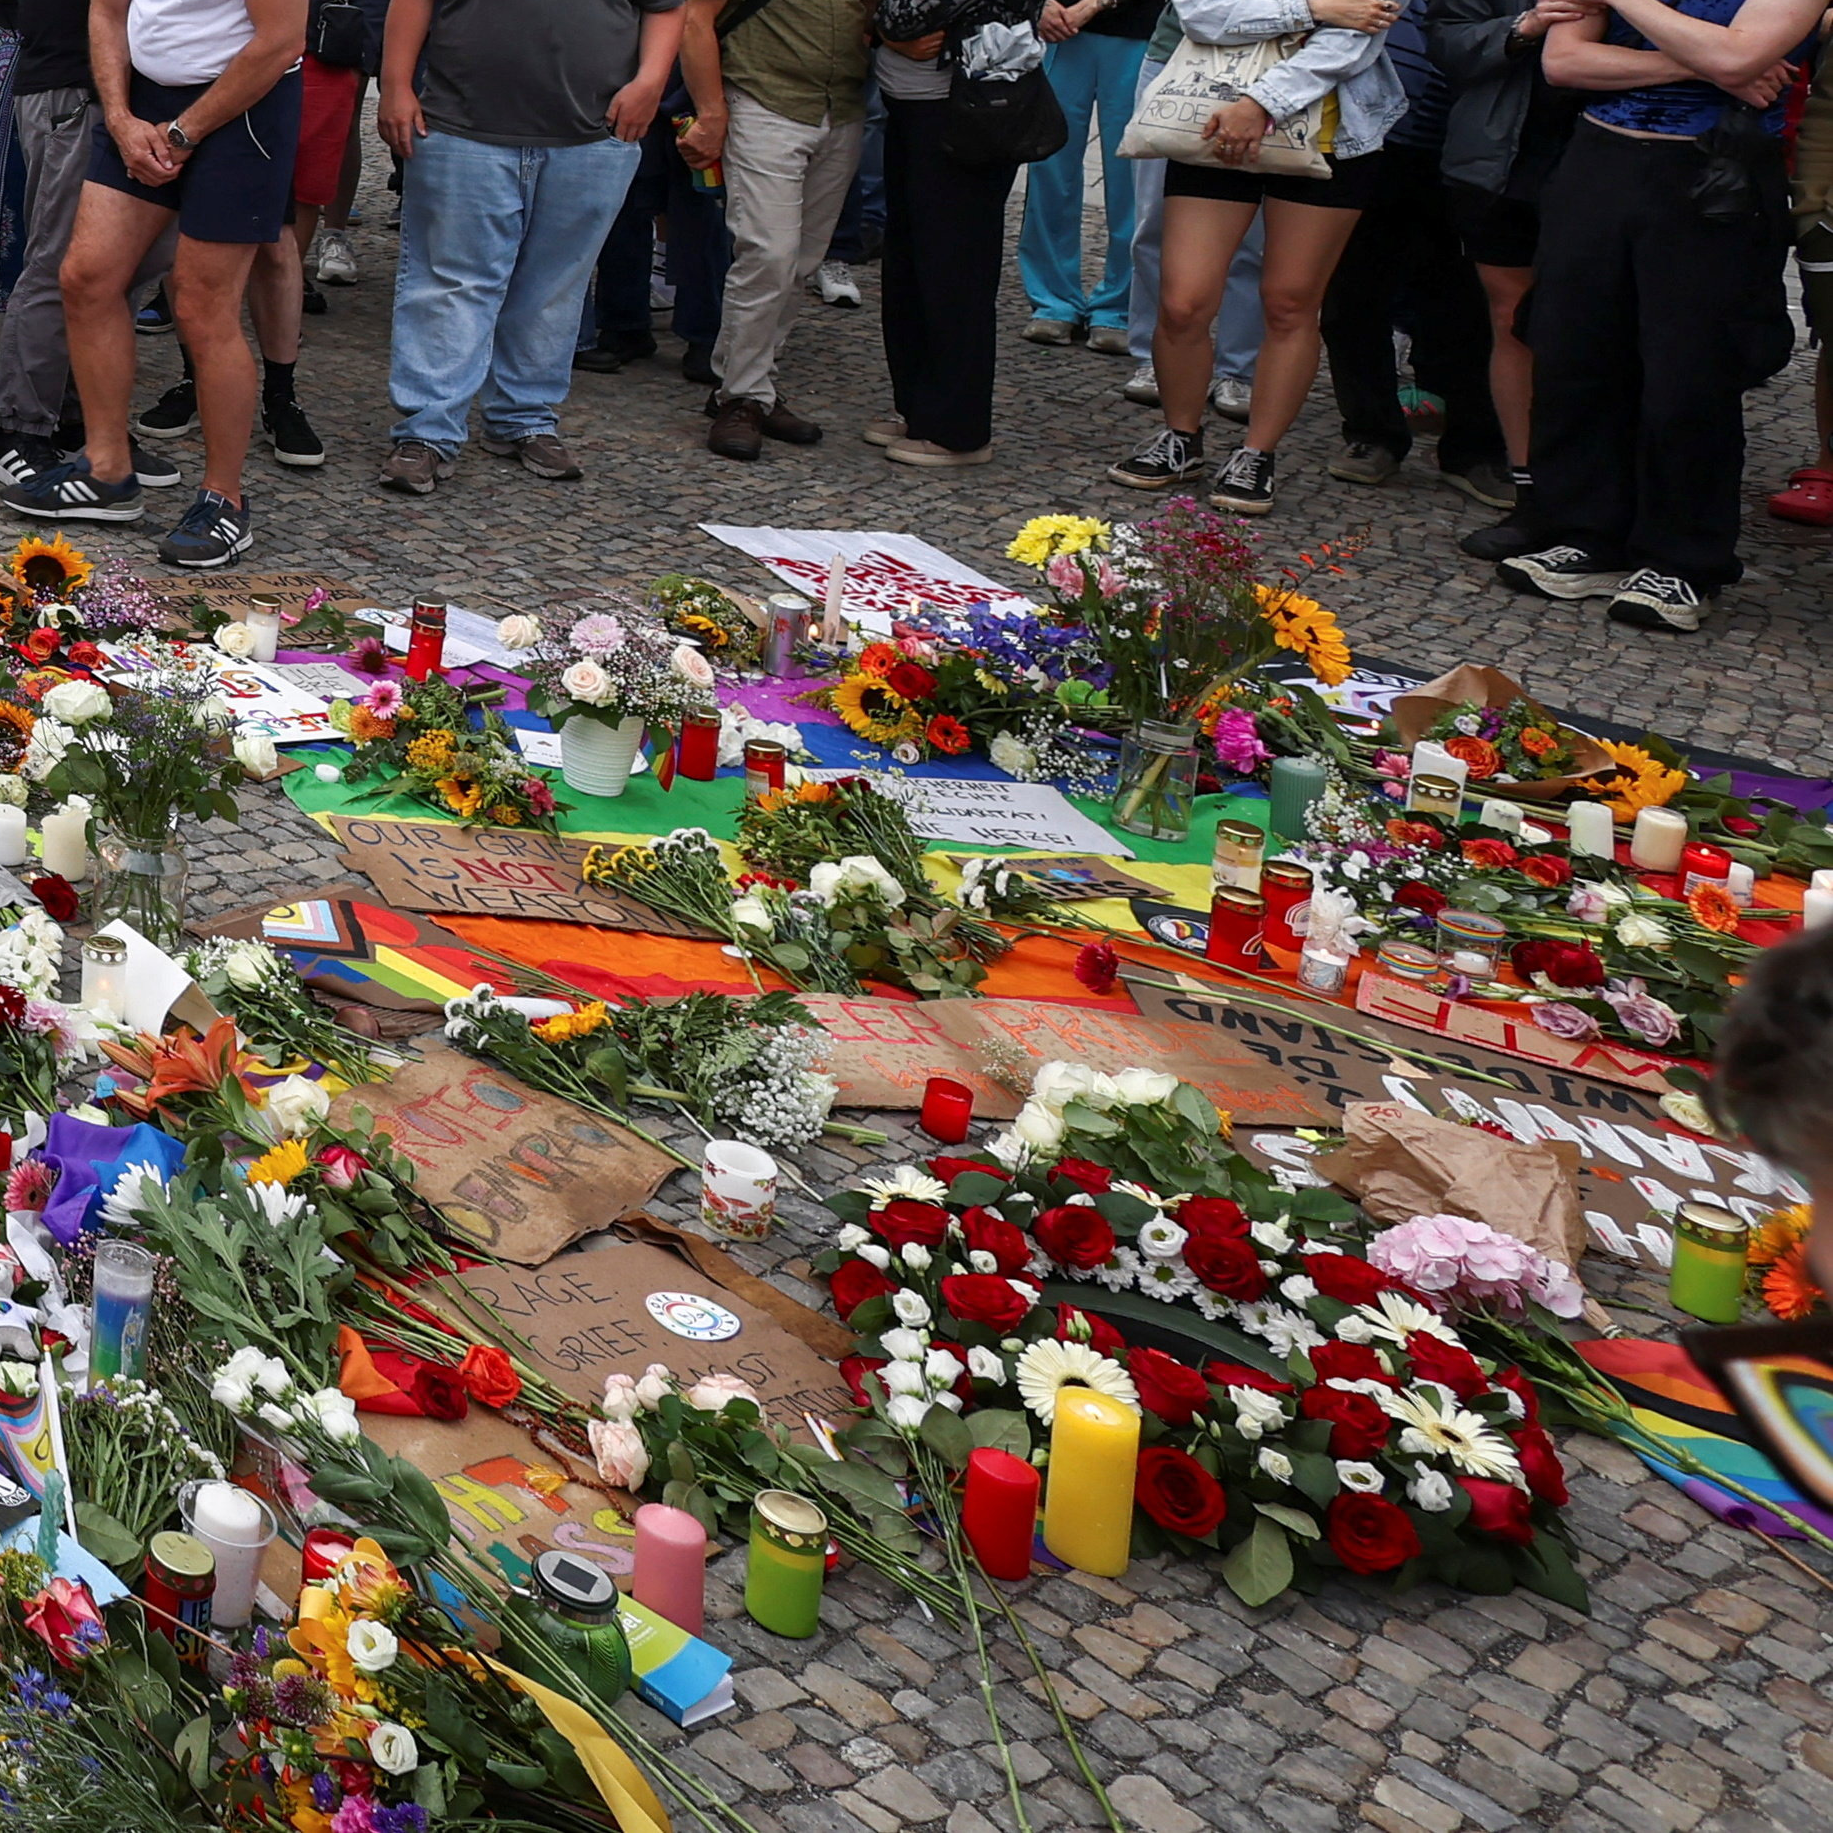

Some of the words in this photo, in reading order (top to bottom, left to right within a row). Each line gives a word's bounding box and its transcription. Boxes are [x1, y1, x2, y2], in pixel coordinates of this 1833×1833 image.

[348, 821, 469, 851] OUR
[476, 832, 597, 867] GRIE
[391, 852, 461, 881] IS
[454, 856, 573, 894] NOT
[649, 1293, 673, 1316] LOVE
